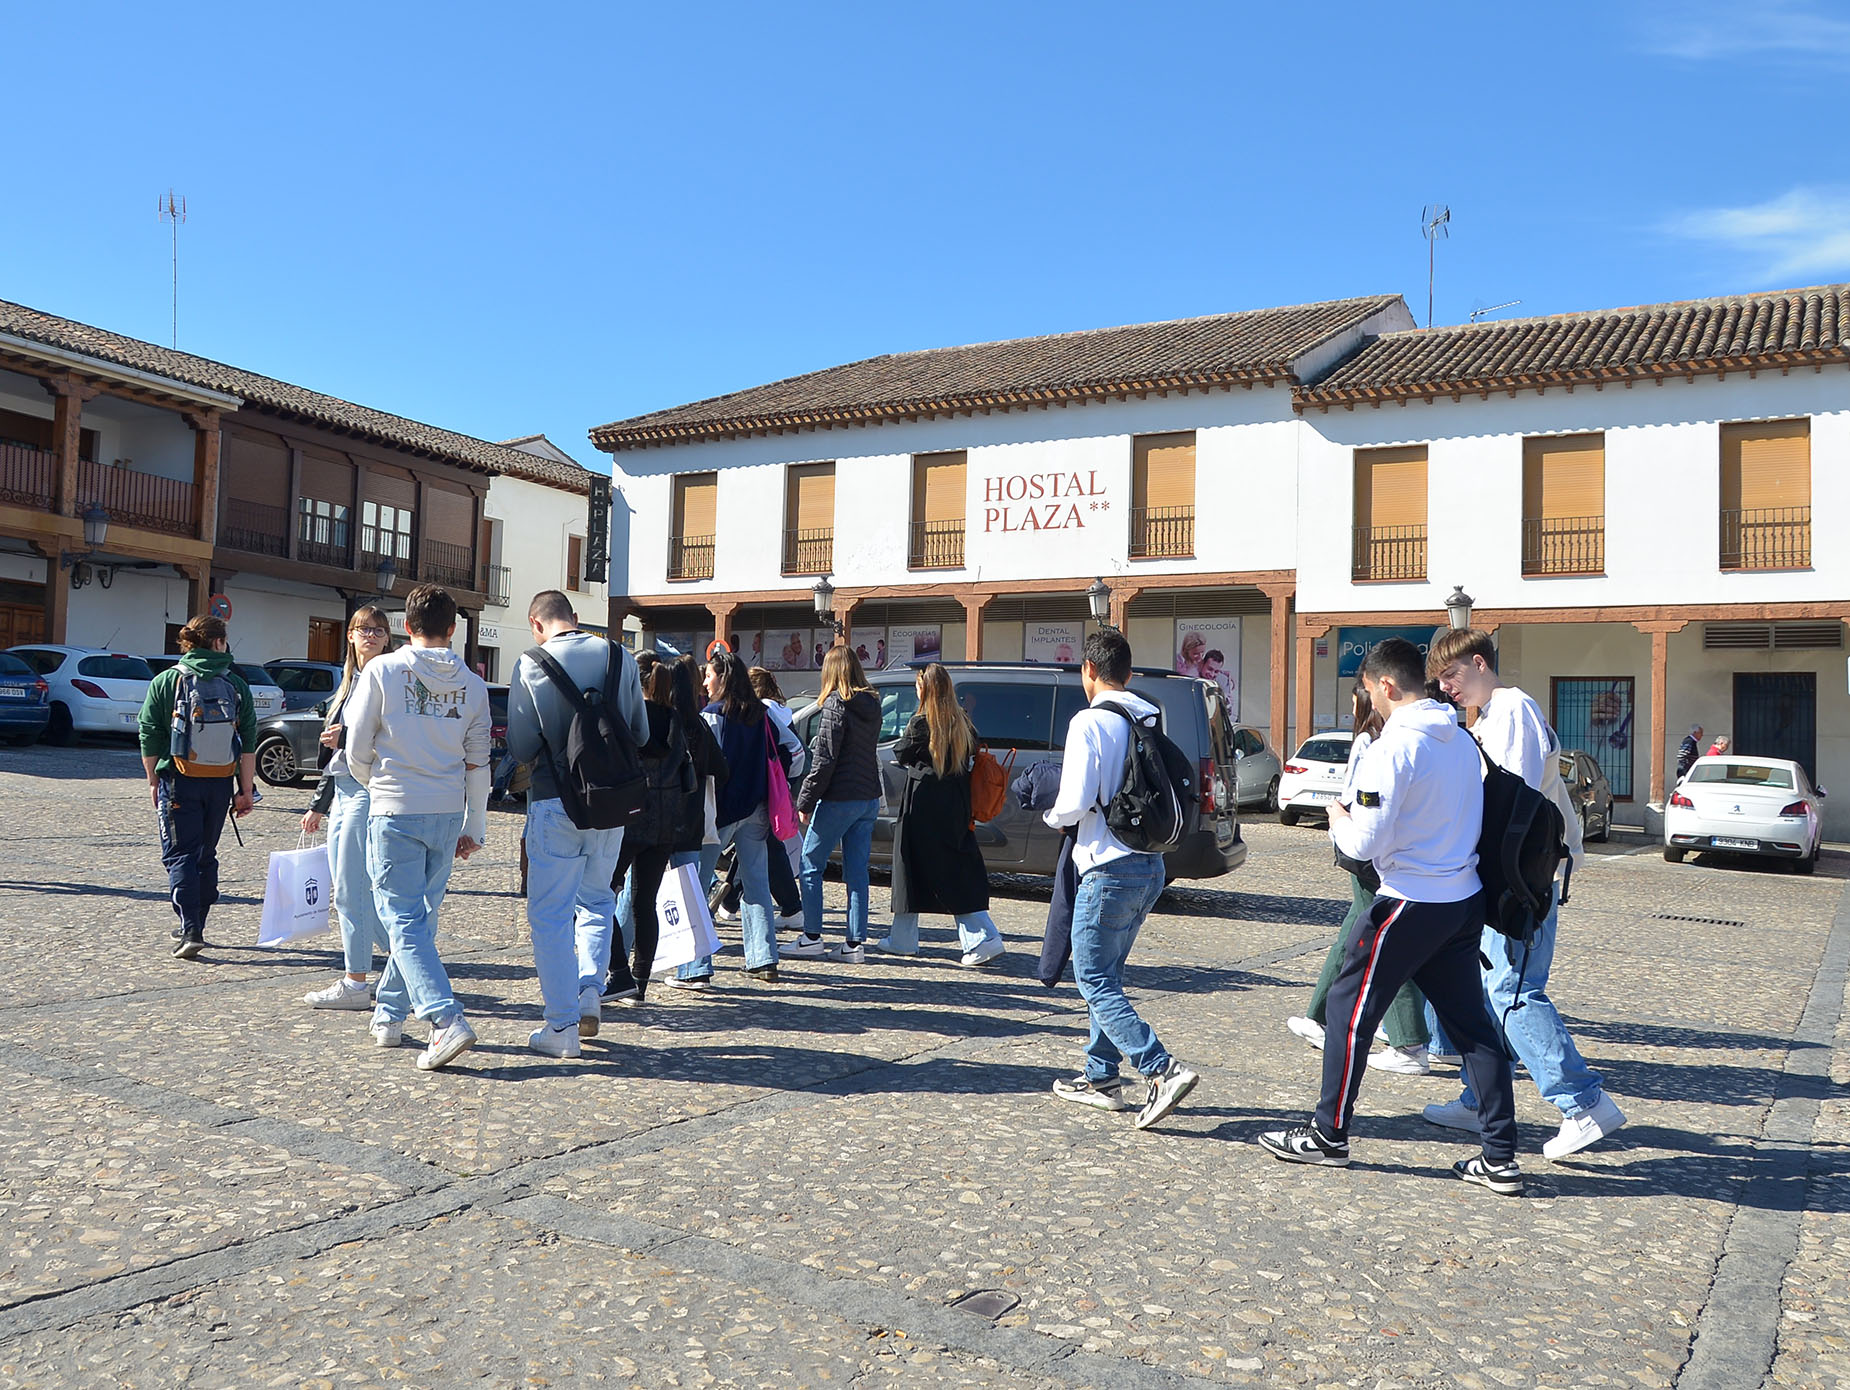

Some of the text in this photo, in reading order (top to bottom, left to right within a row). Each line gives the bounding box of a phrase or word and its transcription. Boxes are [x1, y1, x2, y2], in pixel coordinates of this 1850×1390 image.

[984, 470, 1107, 502] HOSTAL
[592, 509, 604, 574] PLAZA
[1031, 636, 1077, 644] IMPLANTES
[1038, 627, 1070, 635] DENTAL
